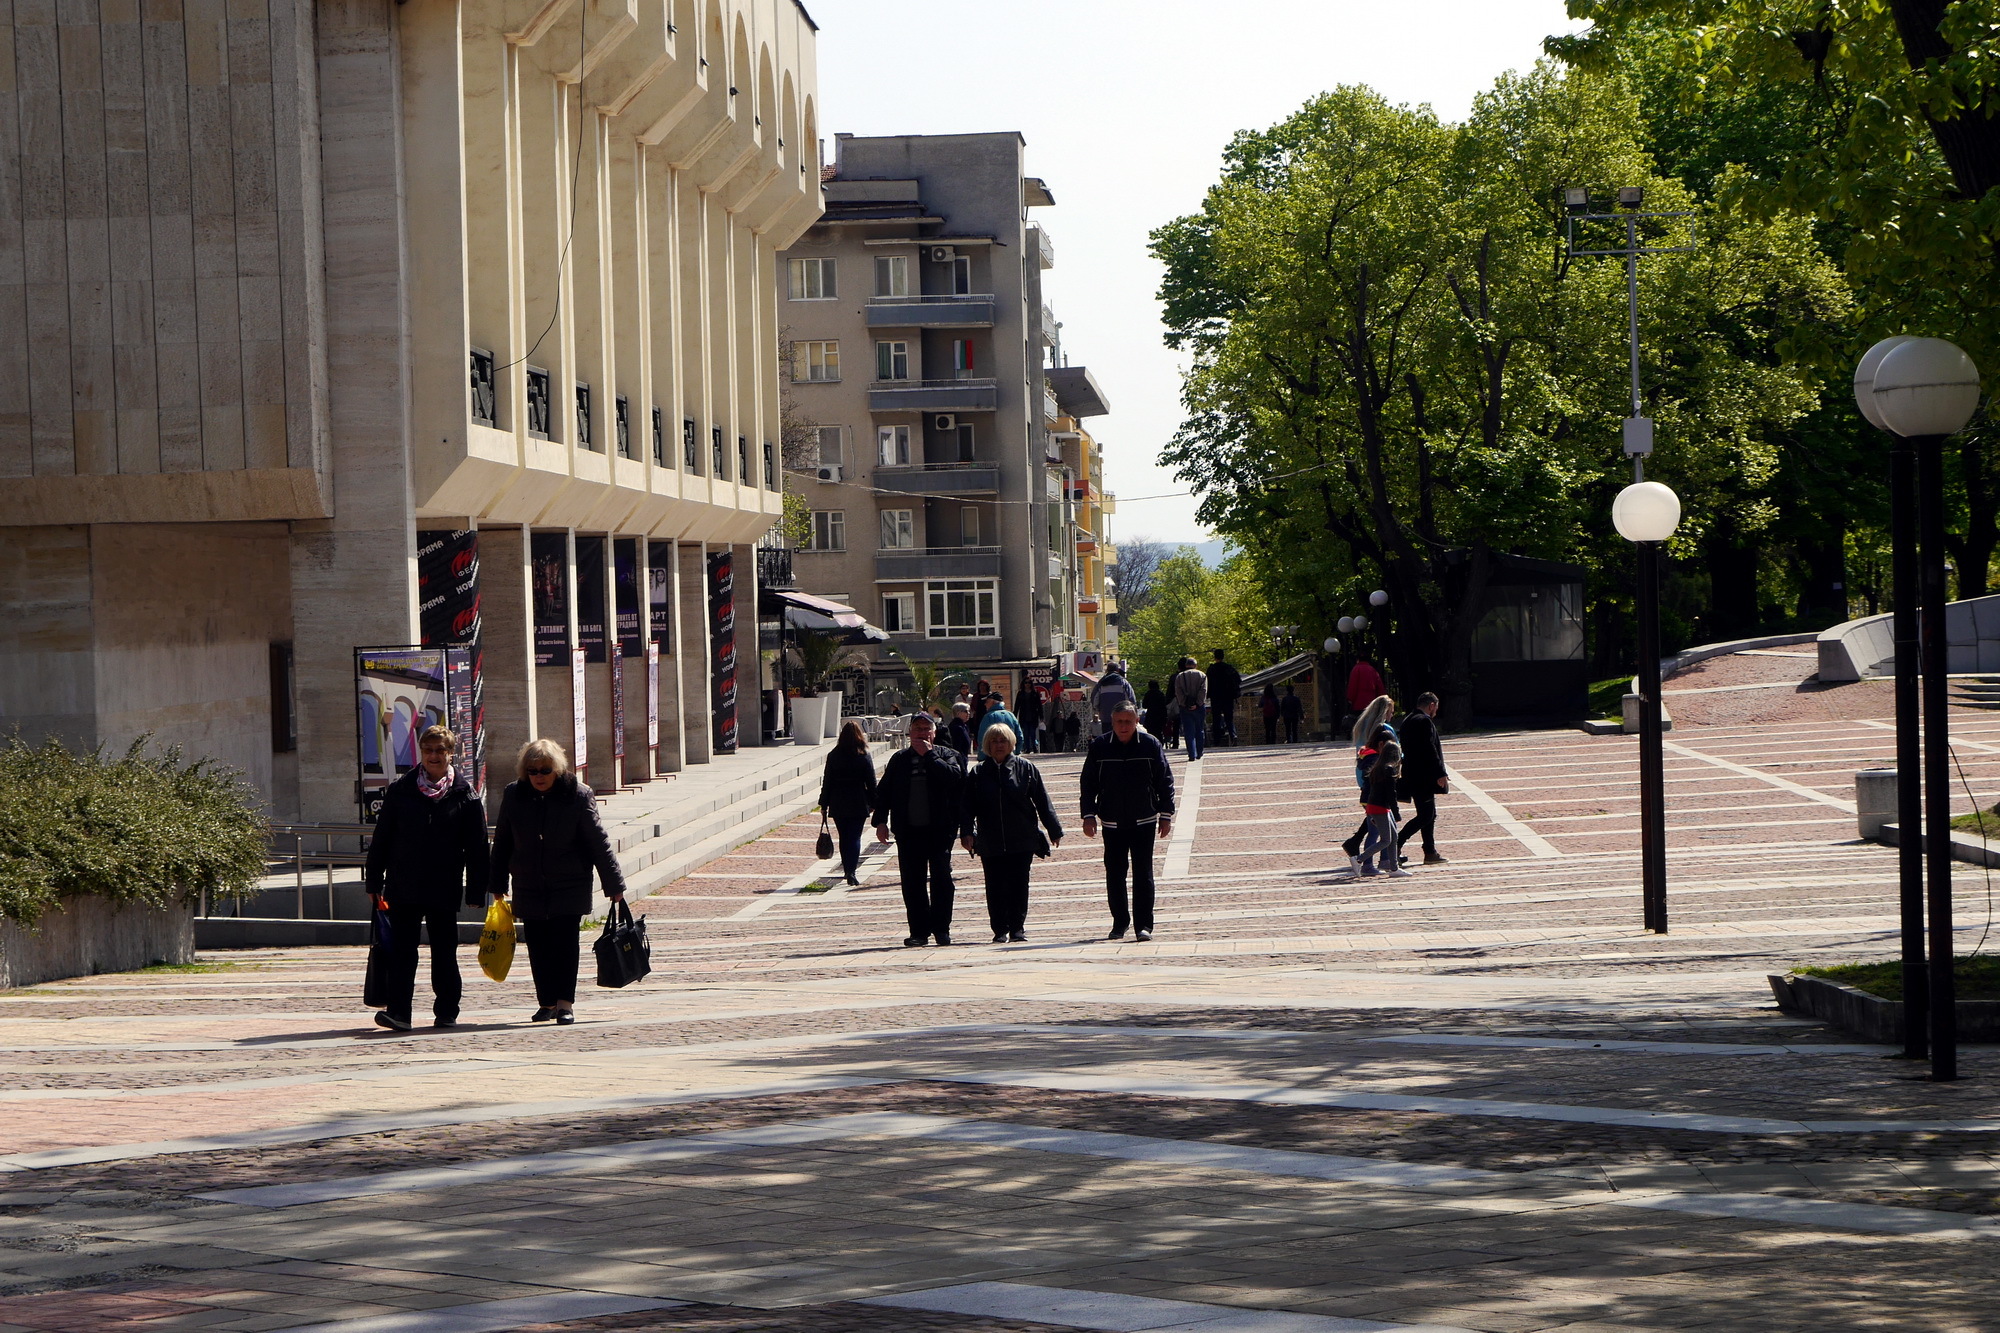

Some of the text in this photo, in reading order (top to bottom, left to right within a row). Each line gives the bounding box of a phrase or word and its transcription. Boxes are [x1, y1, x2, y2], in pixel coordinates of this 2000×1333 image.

[1083, 654, 1097, 669] A1
[1027, 669, 1051, 677] NON
[1031, 676, 1053, 684] TOP
